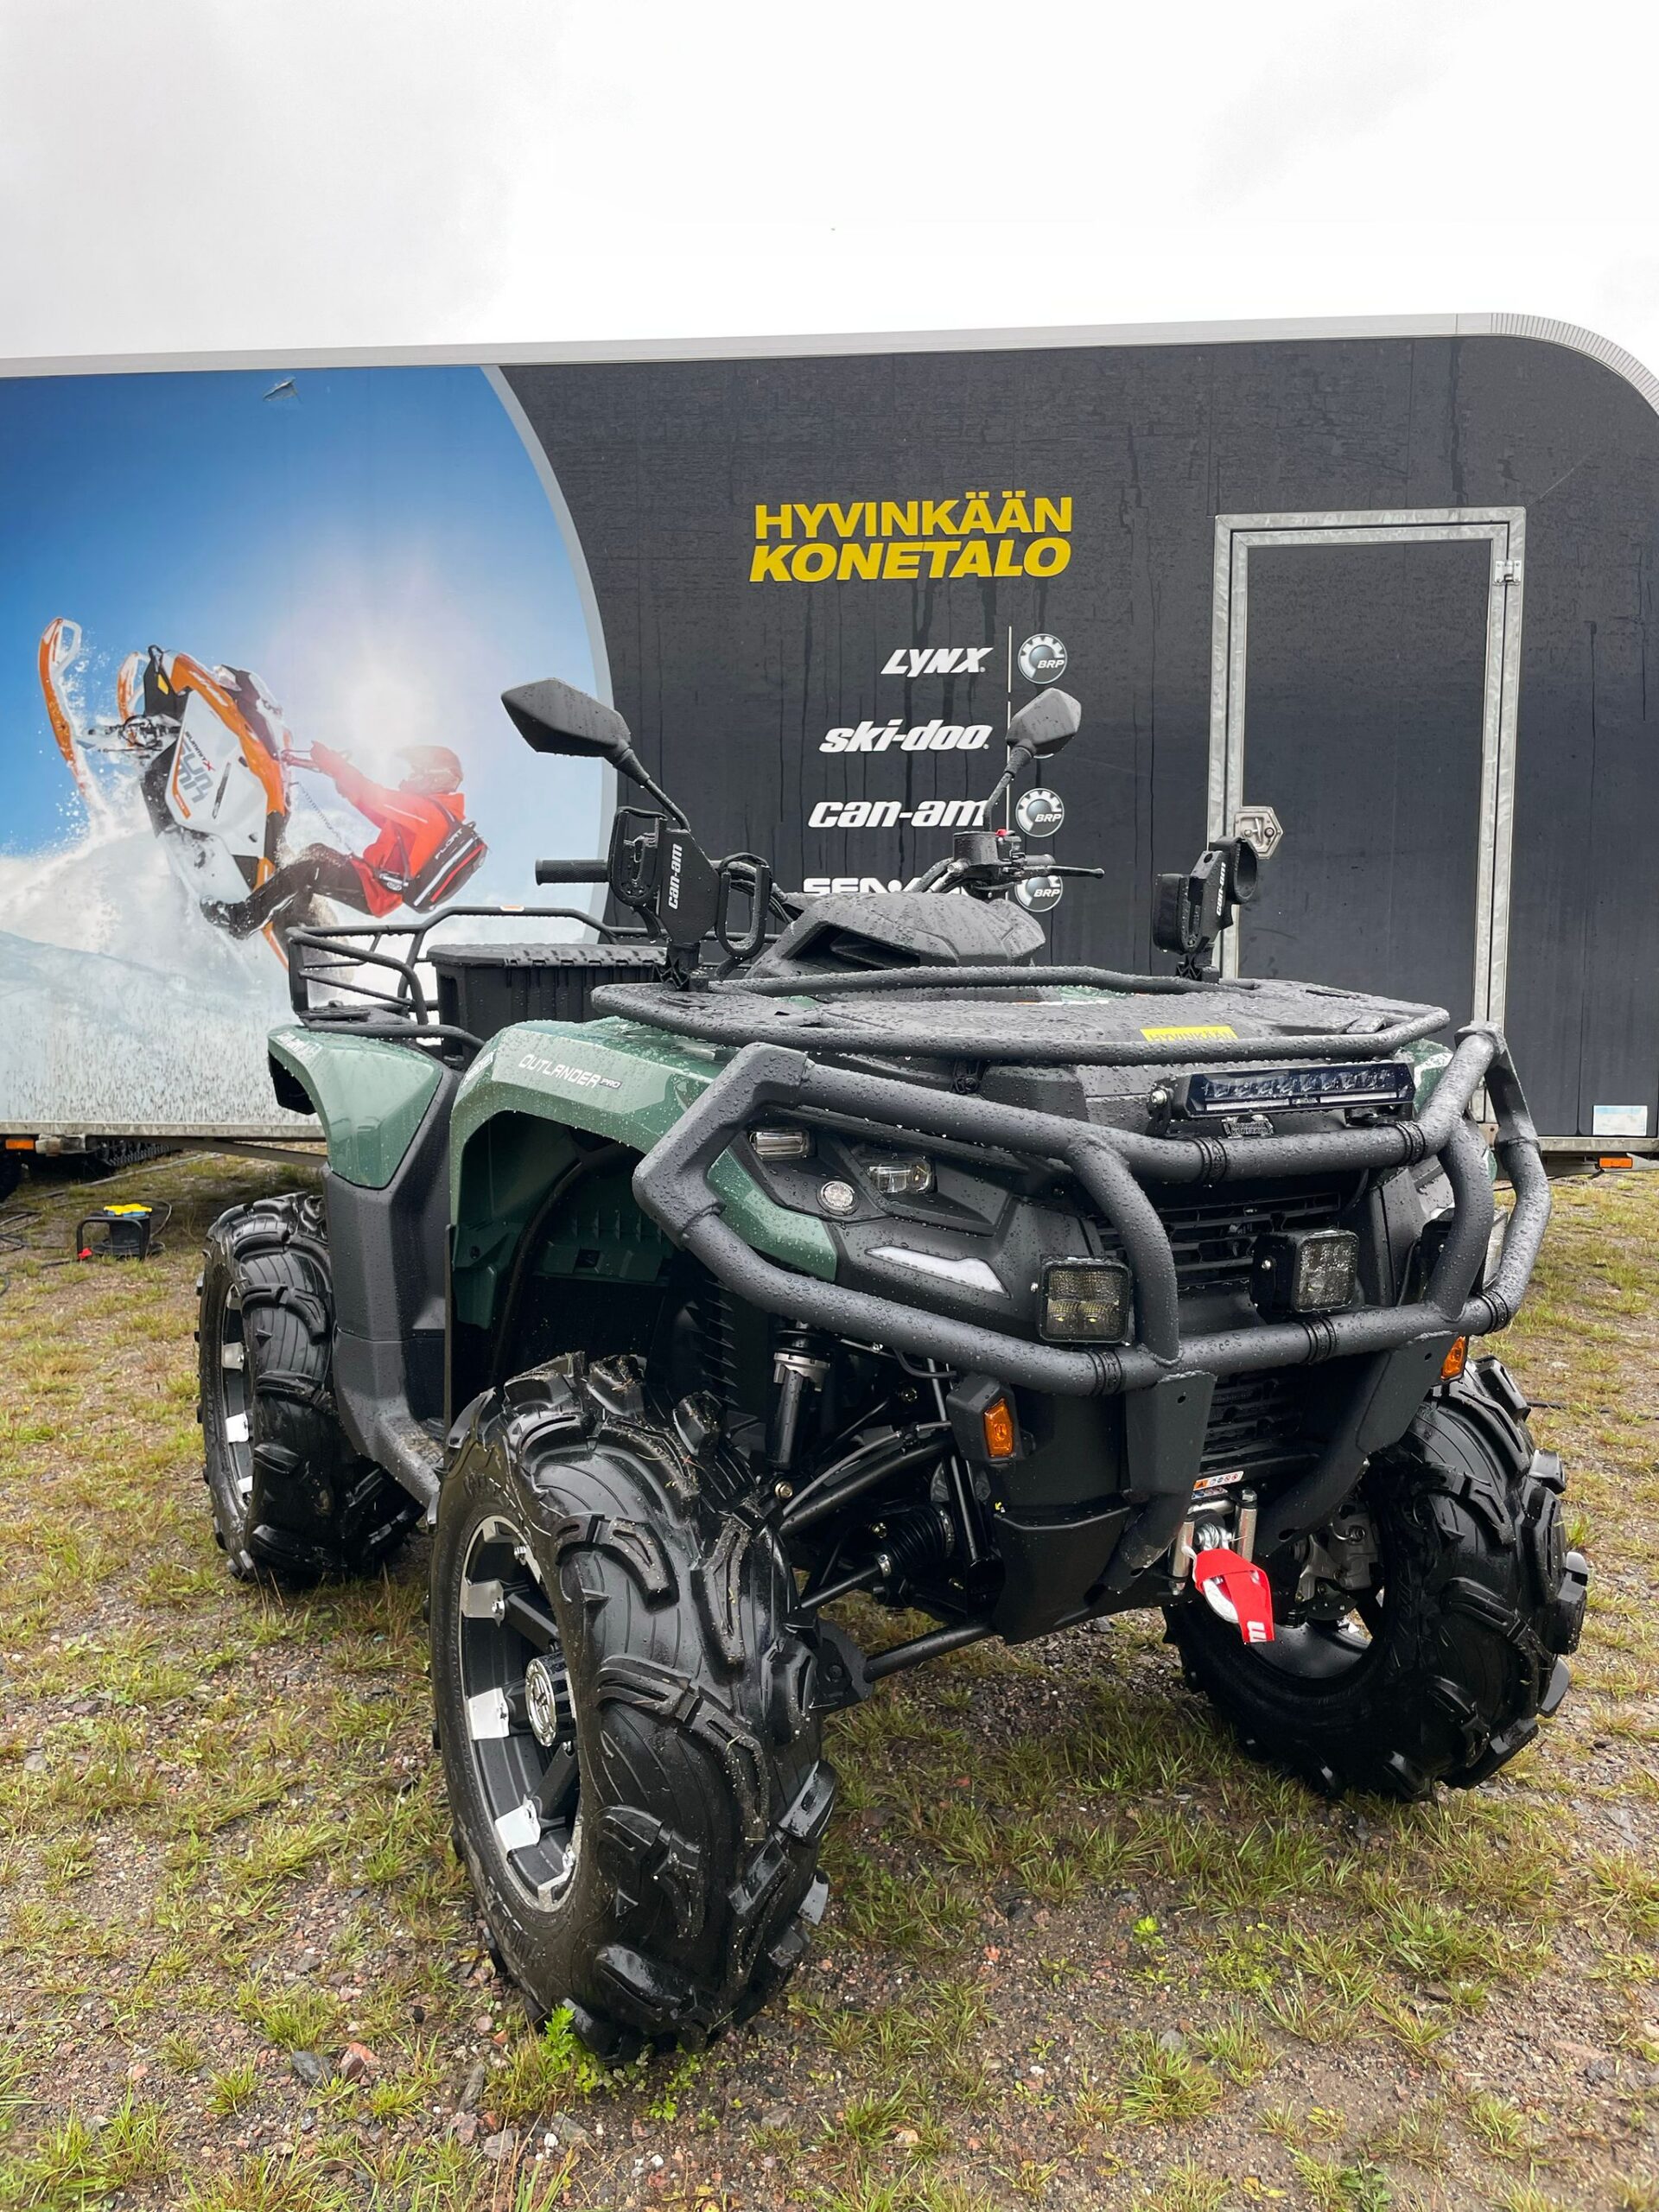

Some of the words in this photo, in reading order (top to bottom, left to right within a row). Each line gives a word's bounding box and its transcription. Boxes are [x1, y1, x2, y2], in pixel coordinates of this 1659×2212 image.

[754, 490, 1072, 539] HYVINKÄÄN
[749, 537, 1072, 582] KONETALO
[880, 647, 994, 677] LYNX
[1037, 659, 1065, 669] BRP
[819, 719, 994, 753] ski-doo
[808, 800, 989, 828] can-am
[1034, 813, 1062, 823] BRP
[668, 843, 683, 910] can-am
[1033, 888, 1061, 898] BRP
[518, 1054, 602, 1089] OUTLANDER
[600, 1078, 622, 1089] PRO
